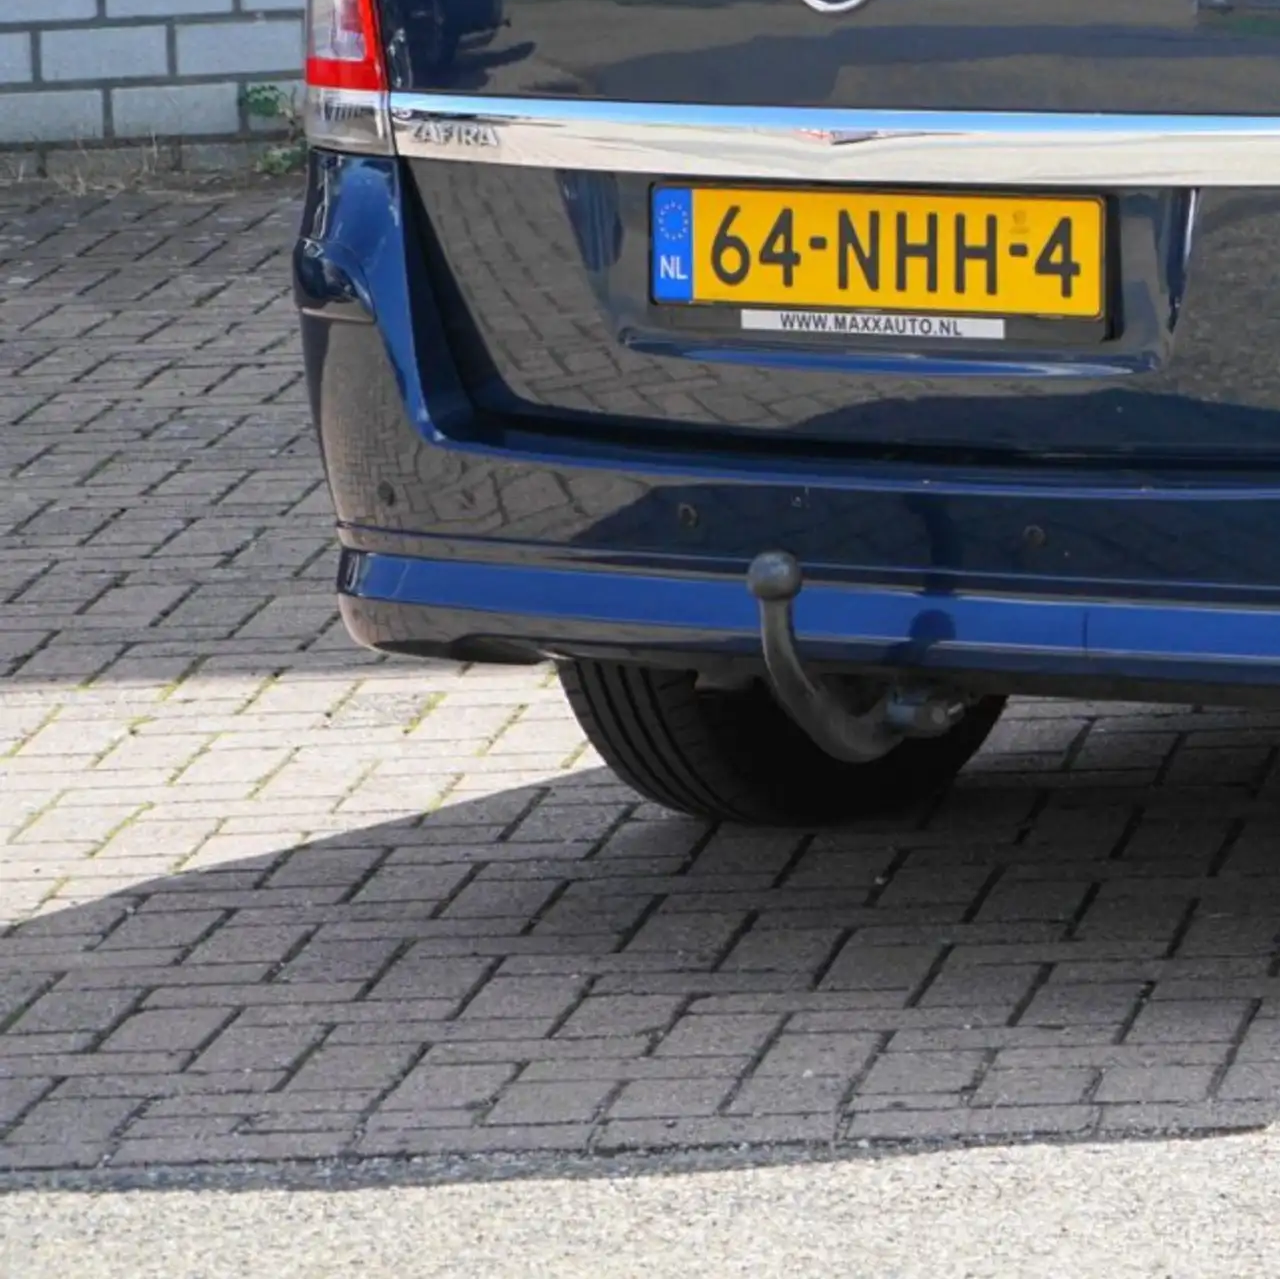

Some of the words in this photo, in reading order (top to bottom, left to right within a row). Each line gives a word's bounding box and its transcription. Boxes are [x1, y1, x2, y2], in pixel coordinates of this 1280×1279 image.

[411, 120, 499, 147] ZAFIRA
[710, 205, 1082, 299] 64-NHH-4
[660, 254, 688, 280] NL
[780, 313, 963, 336] WWW.MAXXAUTO.NL
